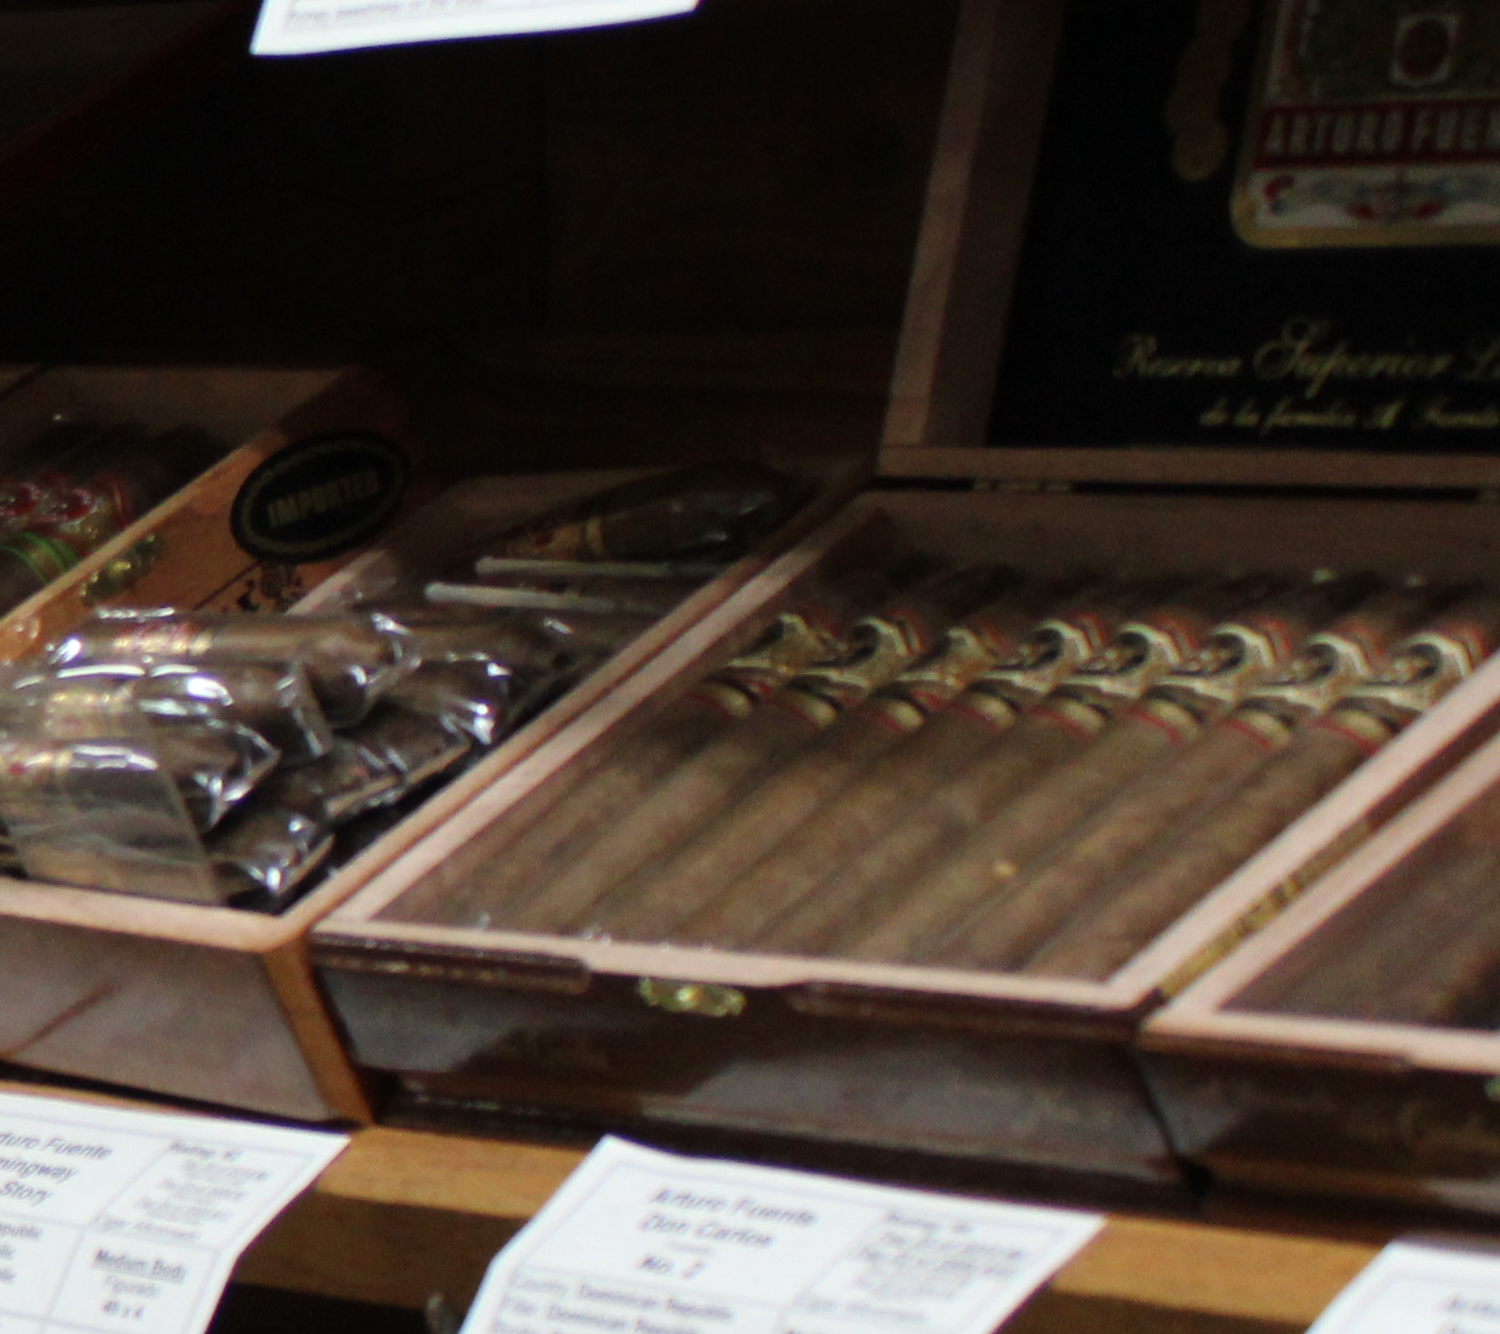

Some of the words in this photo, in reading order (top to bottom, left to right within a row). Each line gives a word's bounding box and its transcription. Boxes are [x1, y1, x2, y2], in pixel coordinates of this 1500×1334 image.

[1264, 113, 1403, 155] ARTURO
[266, 471, 380, 529] IMPORTED
[43, 1136, 112, 1159] Fuente
